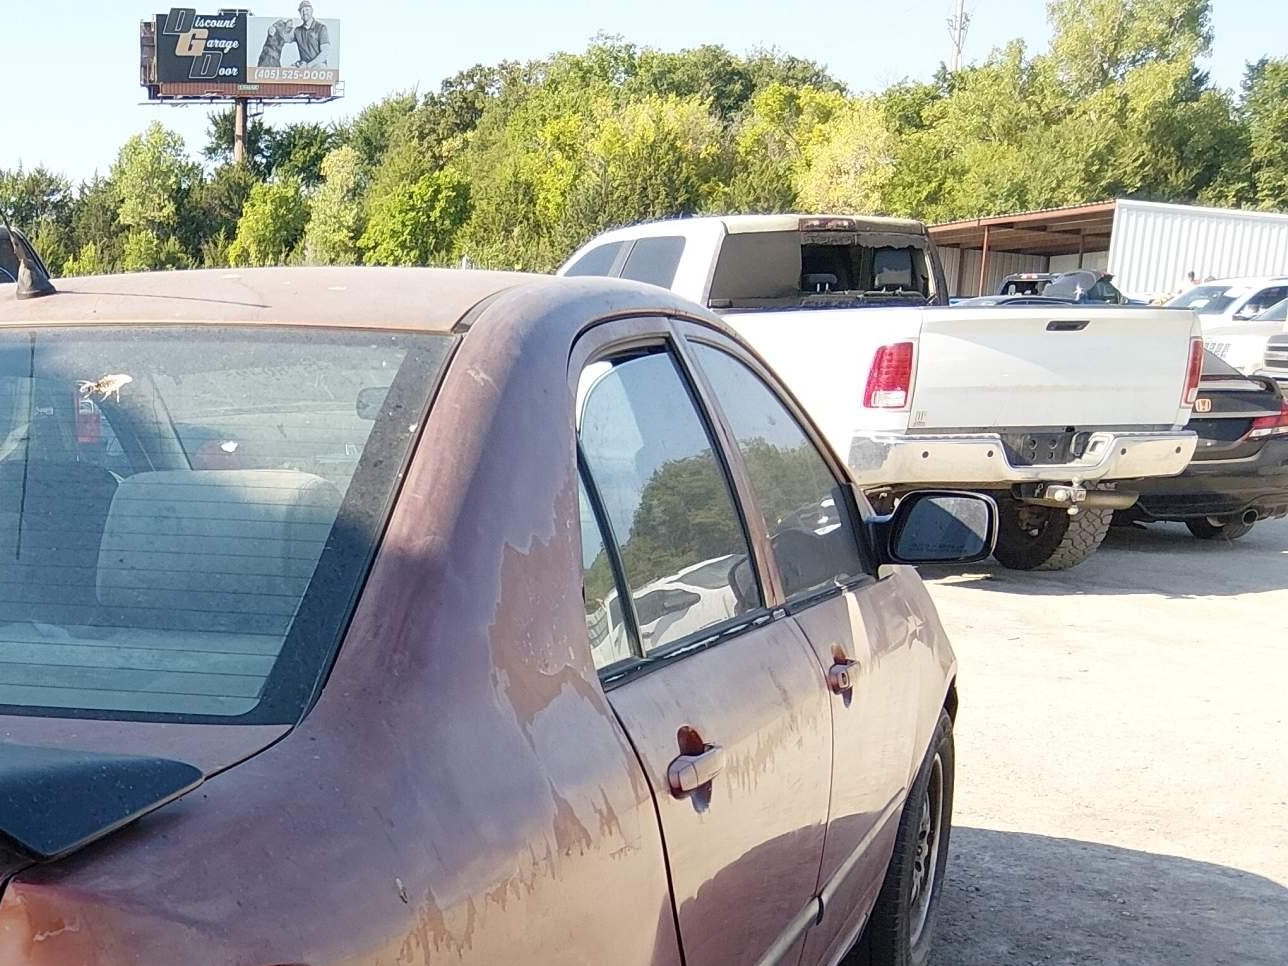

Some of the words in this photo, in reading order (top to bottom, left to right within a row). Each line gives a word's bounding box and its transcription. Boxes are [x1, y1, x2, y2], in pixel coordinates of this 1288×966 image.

[163, 8, 236, 34] Discount
[175, 29, 239, 56] Garage
[189, 51, 238, 78] Door
[254, 69, 279, 82] (405)
[282, 69, 333, 81] 525-DOOR
